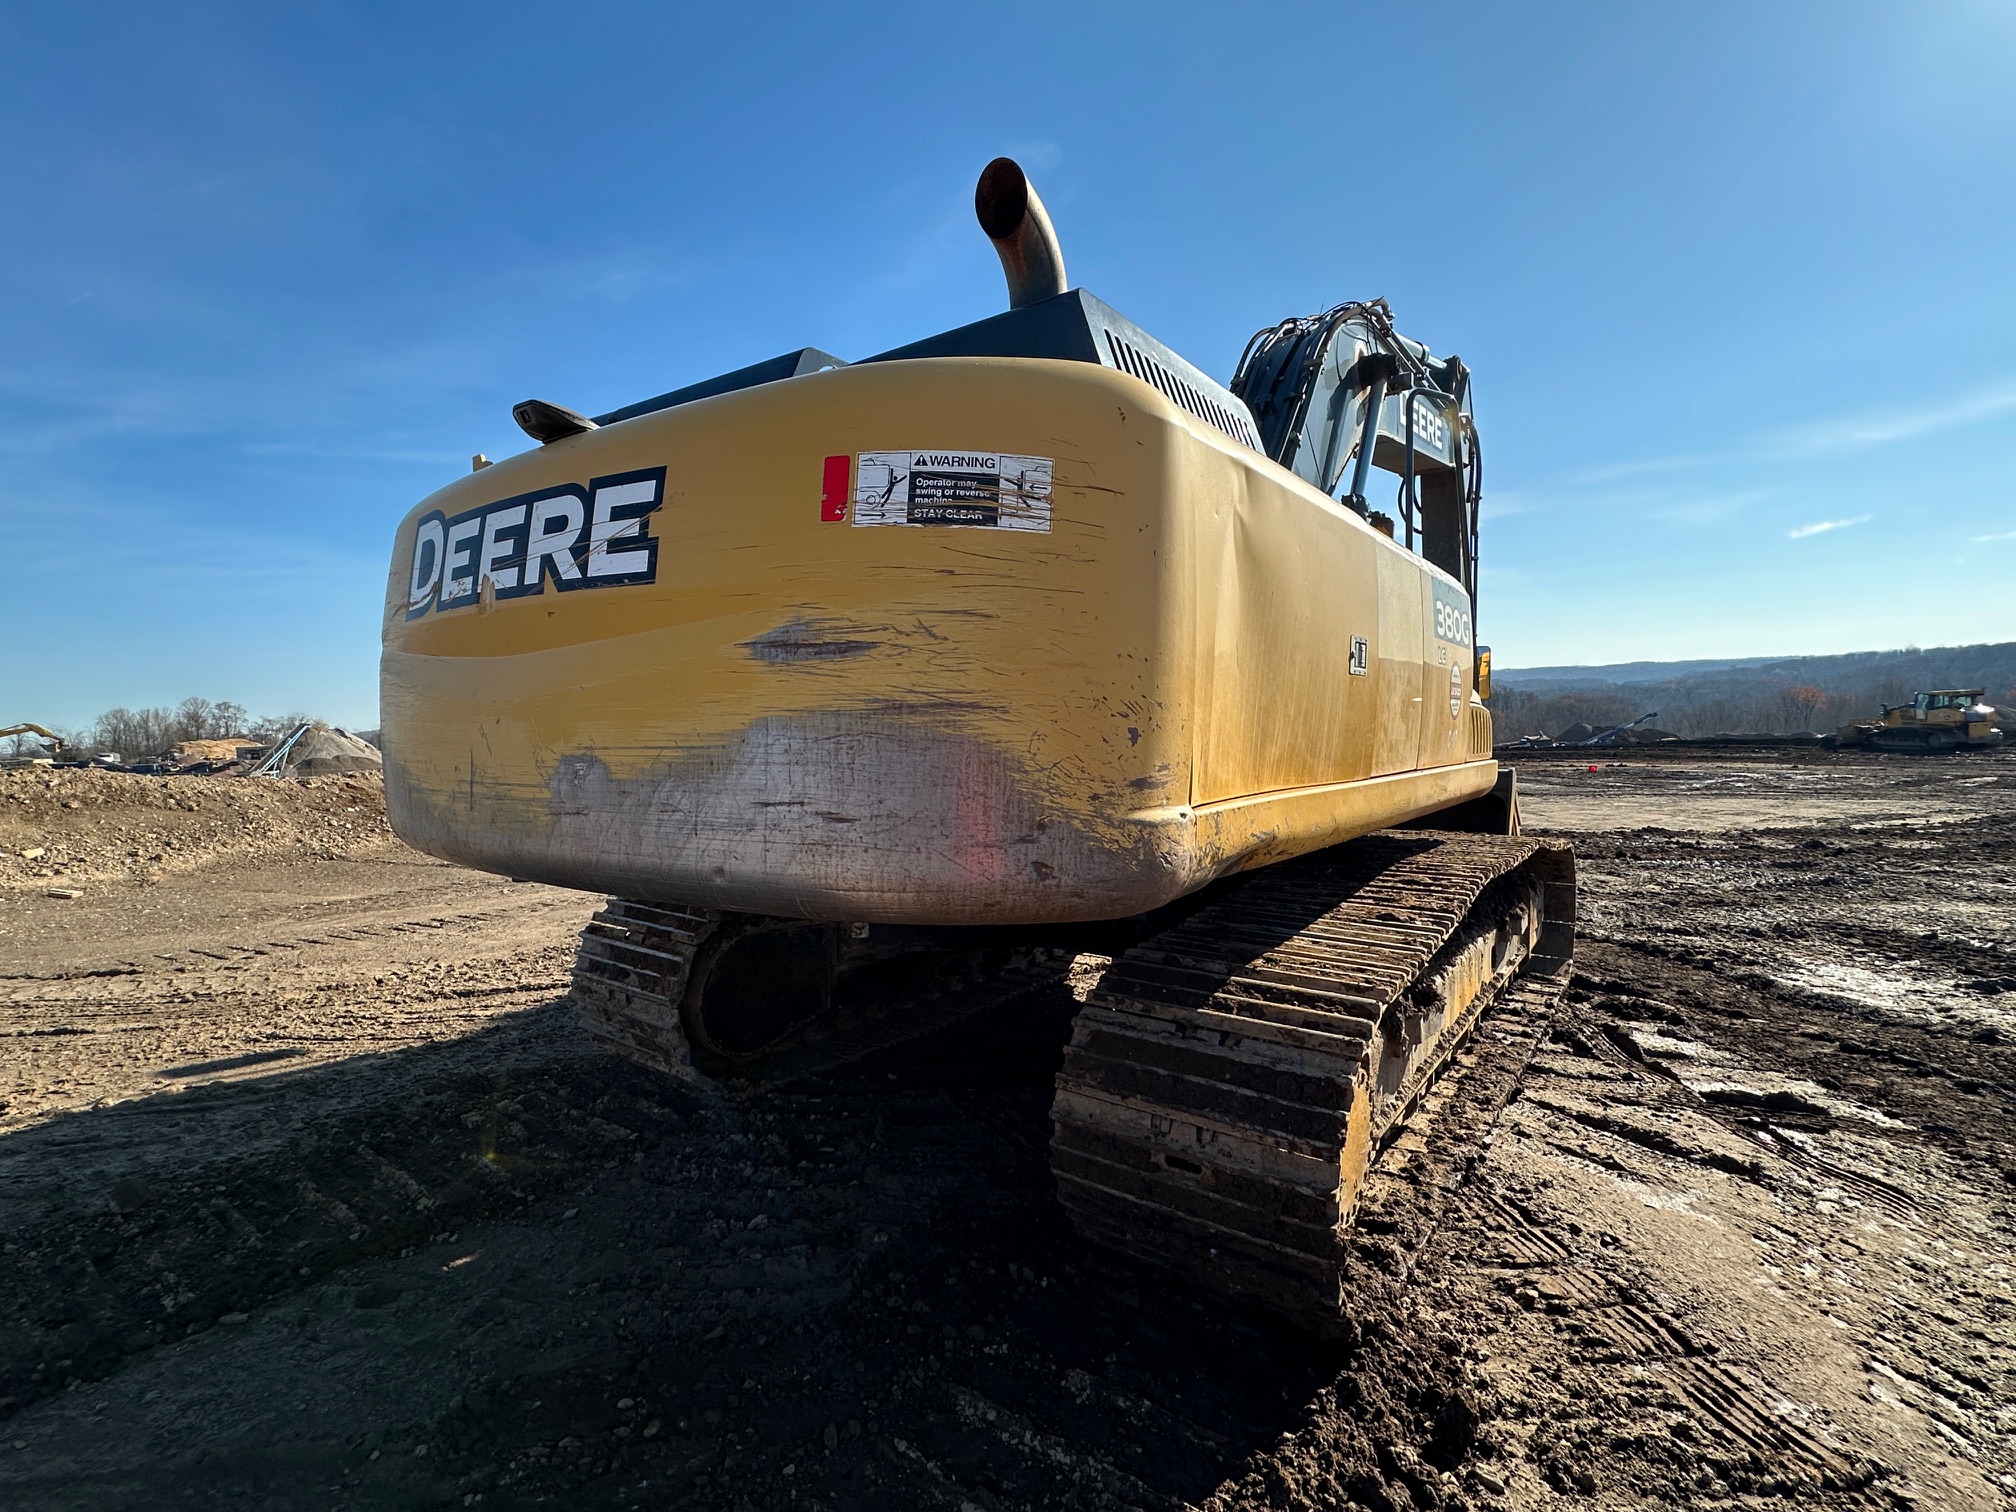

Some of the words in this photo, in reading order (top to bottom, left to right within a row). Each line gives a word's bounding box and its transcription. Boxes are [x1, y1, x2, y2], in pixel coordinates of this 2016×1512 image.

[929, 455, 995, 469] WARNING
[916, 477, 955, 487] Operator
[957, 480, 977, 489] may
[915, 487, 942, 497] swing
[914, 508, 943, 518] STAY
[945, 509, 983, 520] CLEAR
[409, 480, 656, 611] DEERE
[1436, 600, 1470, 646] 380G
